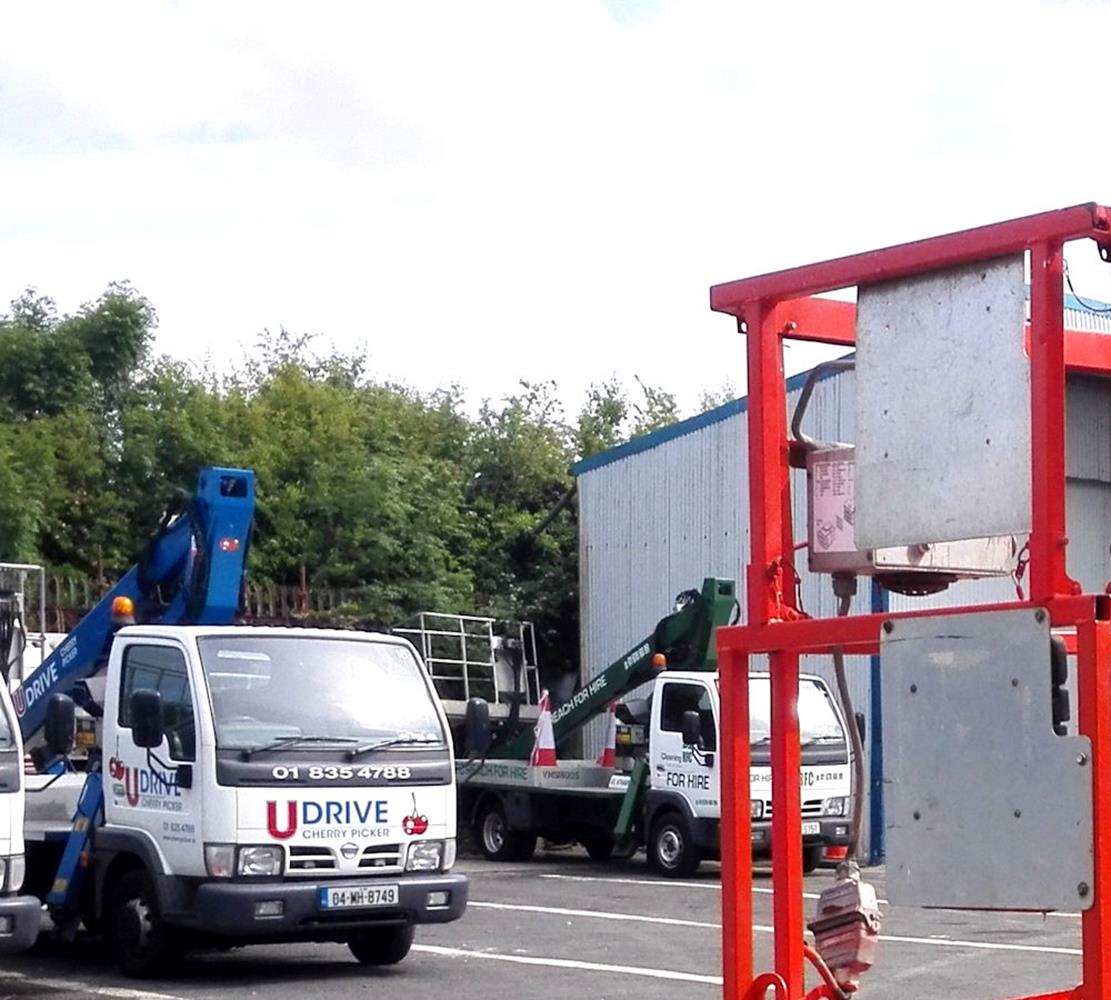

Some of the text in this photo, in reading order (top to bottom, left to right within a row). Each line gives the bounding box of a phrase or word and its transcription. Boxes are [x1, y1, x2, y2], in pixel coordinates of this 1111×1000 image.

[25, 661, 59, 707] DRIVE
[573, 689, 590, 707] FOR
[588, 674, 608, 696] HIRE
[272, 766, 411, 780] 01 835 4788
[666, 772, 710, 790] FOR HIRE
[302, 800, 389, 825] DRIVE
[302, 827, 390, 840] CHERRY PICKER
[331, 888, 395, 906] 04-MH-8749
